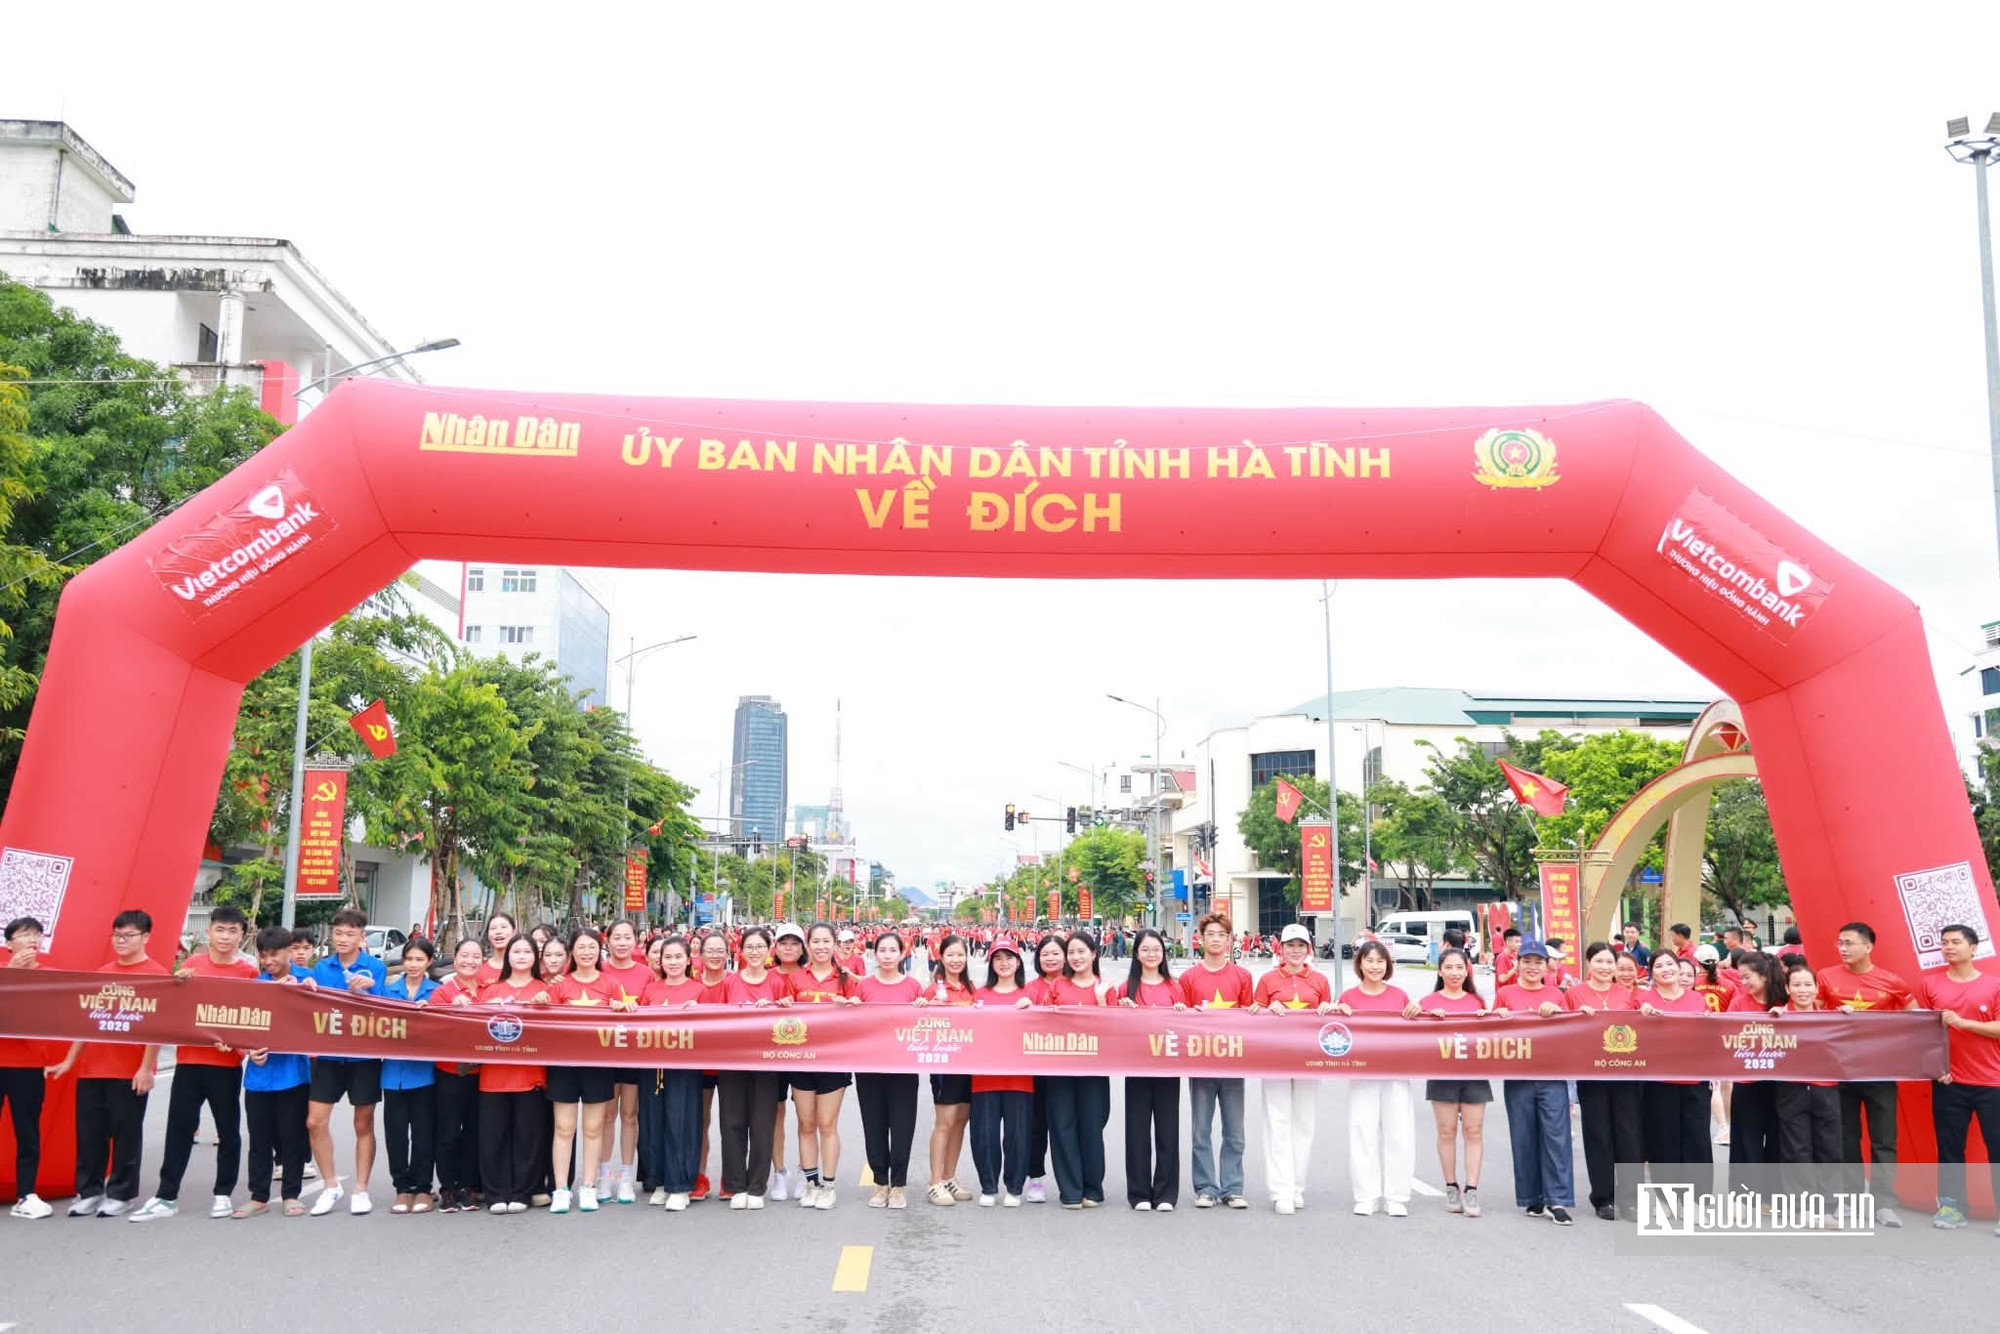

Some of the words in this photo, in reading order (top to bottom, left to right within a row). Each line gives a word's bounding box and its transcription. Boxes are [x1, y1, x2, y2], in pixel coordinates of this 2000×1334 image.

[421, 412, 509, 447] Nhân
[513, 416, 581, 450] Dân
[621, 426, 684, 468] ỦY
[697, 439, 798, 472] BAN
[812, 436, 953, 477] NHÂN
[968, 439, 1072, 478] DÂN
[1084, 437, 1191, 480] TỈNH
[1207, 438, 1276, 479] HÀ
[1283, 441, 1391, 478] TĨNH
[855, 475, 937, 529] VỀ
[967, 480, 1122, 532] ĐÍCH
[171, 502, 320, 601] Vietcombank
[1671, 518, 1806, 628] Vietcombank
[1744, 603, 1770, 626] HÀNH
[101, 982, 136, 997] CÙNG
[79, 992, 118, 1010] VIỆT
[120, 996, 157, 1013] NAM
[195, 1003, 238, 1024] Nhân
[240, 1006, 272, 1026] Dân
[313, 1007, 343, 1036] VỀ
[351, 1011, 407, 1040] ĐÍCH
[1742, 1021, 1775, 1035] CÙNG
[597, 1023, 628, 1048] VỀ
[636, 1024, 694, 1050] ĐÍCH
[1023, 1032, 1065, 1051] Nhân
[1067, 1033, 1098, 1052] Dân
[1148, 1029, 1179, 1057] VỀ
[1186, 1030, 1243, 1058] ĐÍCH
[1437, 1032, 1468, 1060] VỀ
[1476, 1033, 1532, 1060] ĐÍCH
[1721, 1031, 1759, 1049] VIỆT
[1762, 1034, 1797, 1049] NAM
[763, 1050, 776, 1059] BỘ
[777, 1050, 801, 1060] CÔNG
[802, 1051, 817, 1060] AN
[1594, 1058, 1607, 1068] BỘ
[1608, 1058, 1632, 1068] CÔNG
[1633, 1059, 1646, 1067] AN
